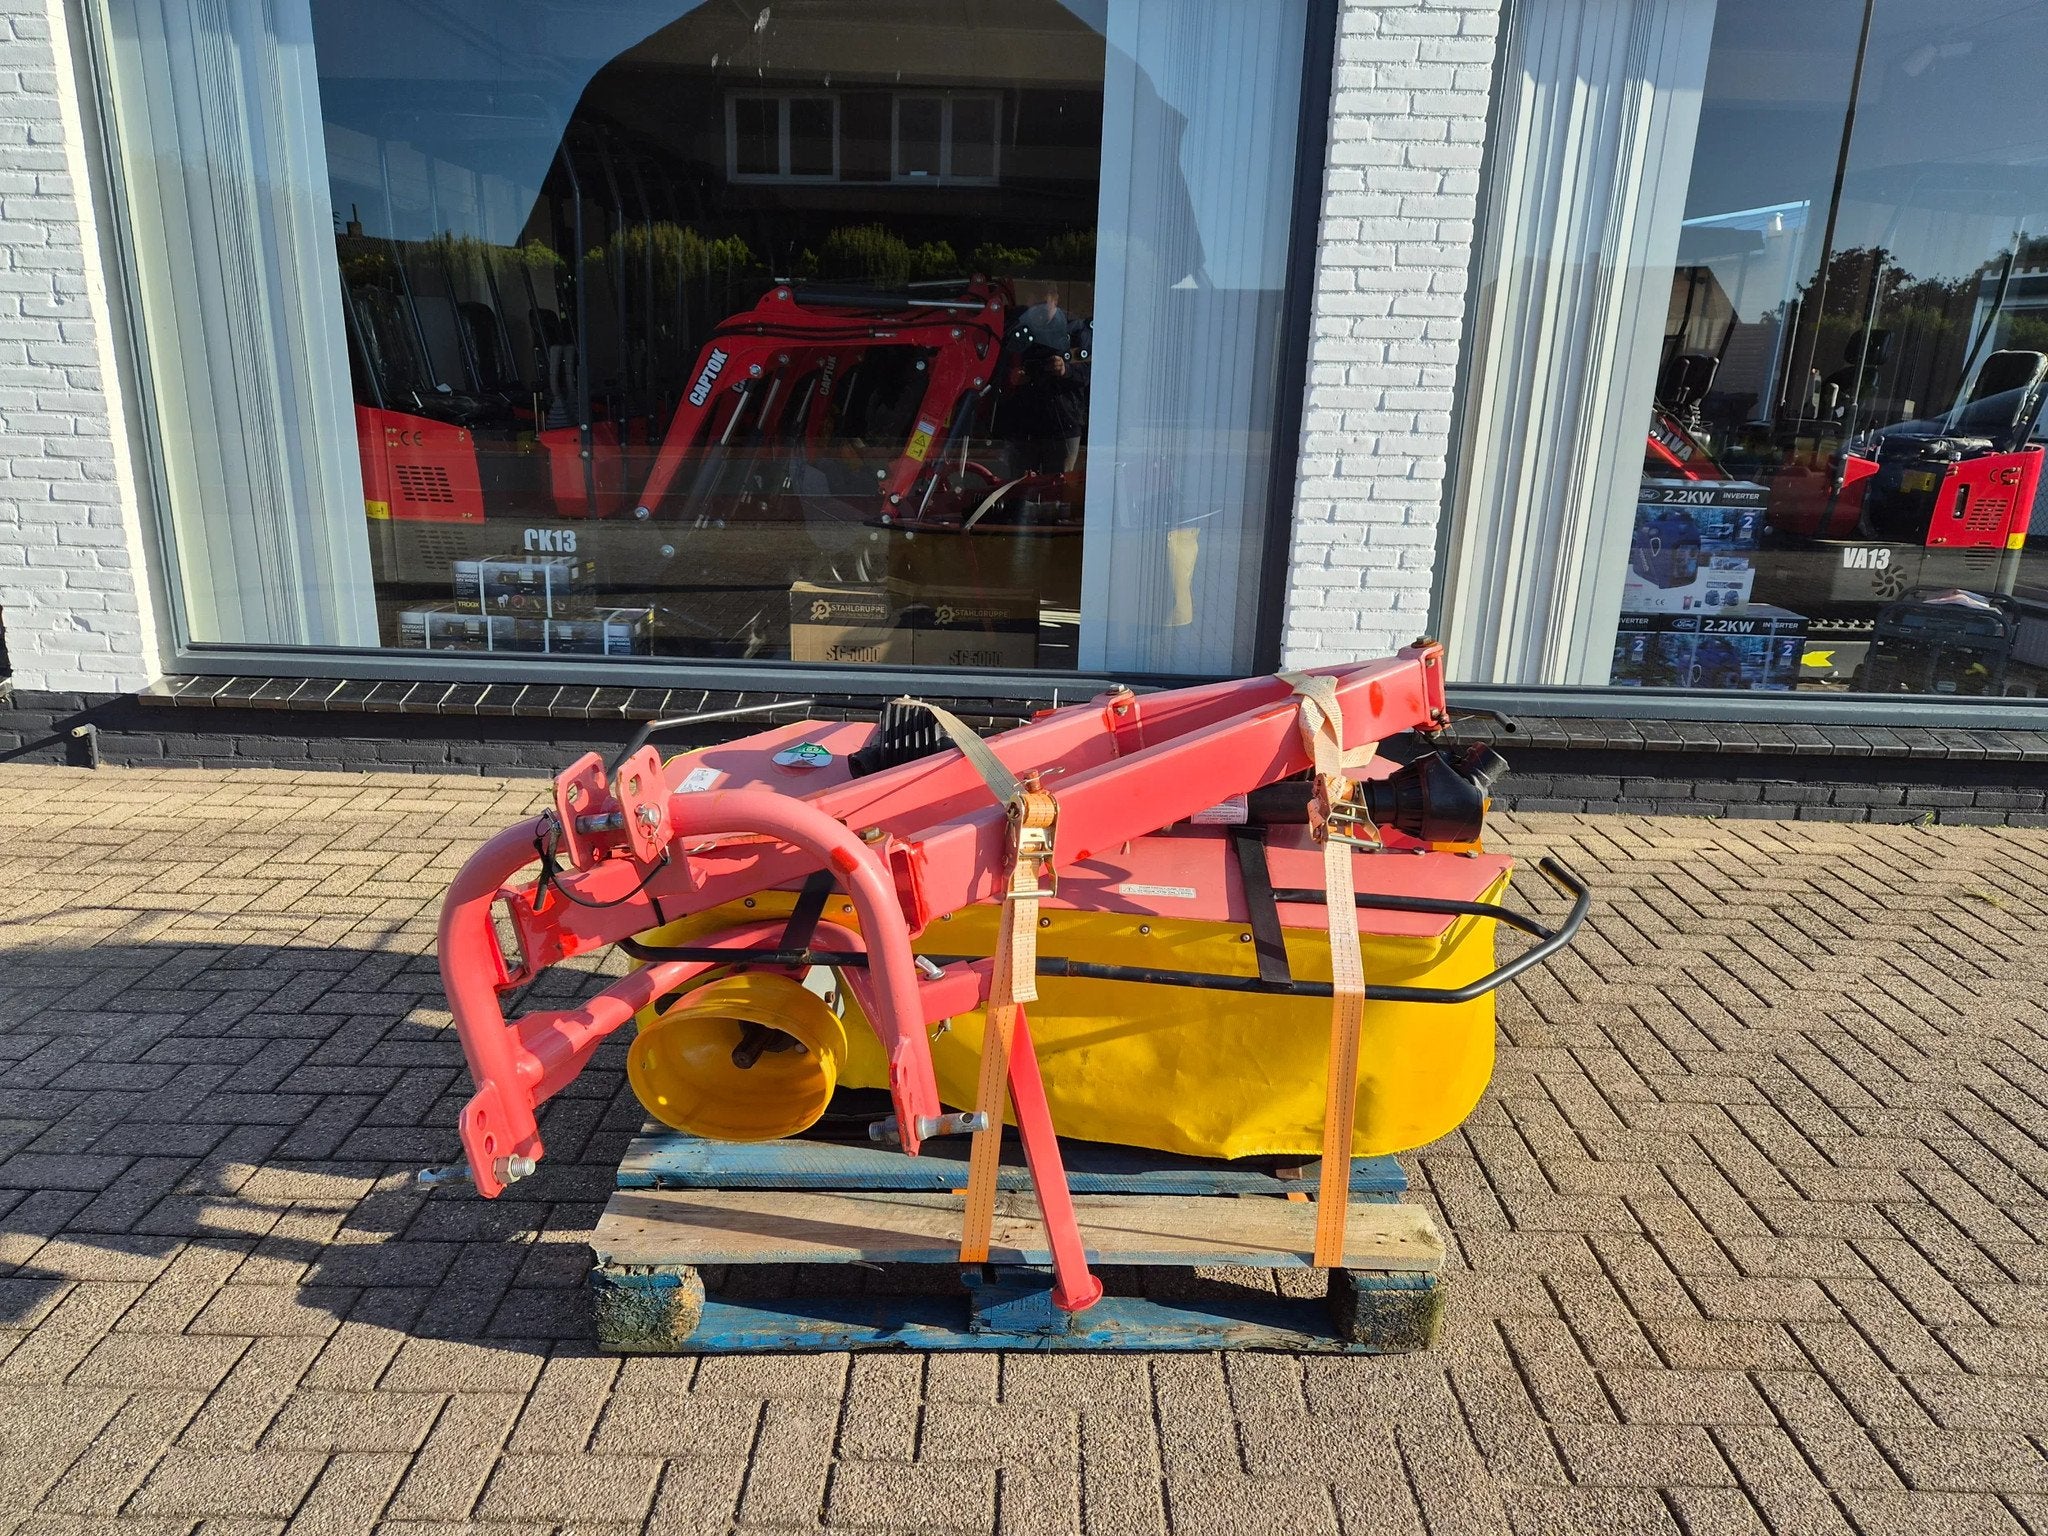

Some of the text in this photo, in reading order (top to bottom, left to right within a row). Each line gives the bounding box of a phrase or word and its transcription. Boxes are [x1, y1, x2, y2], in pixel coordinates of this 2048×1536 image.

[689, 347, 728, 407] CAPTOK
[820, 355, 837, 396] CAPTOK
[1663, 489, 1715, 504] 2.2KW
[1722, 492, 1760, 500] INVERTER
[1742, 516, 1753, 529] 2
[524, 528, 577, 552] CK13
[1843, 547, 1891, 569] VA13
[831, 604, 885, 614] STAHLGRUPPE
[955, 608, 1009, 618] STAHLGRUPPE
[1619, 617, 1649, 625] VERTER
[1703, 619, 1755, 633] 2.2KW
[1634, 639, 1645, 652] 2
[1782, 644, 1793, 656] 2
